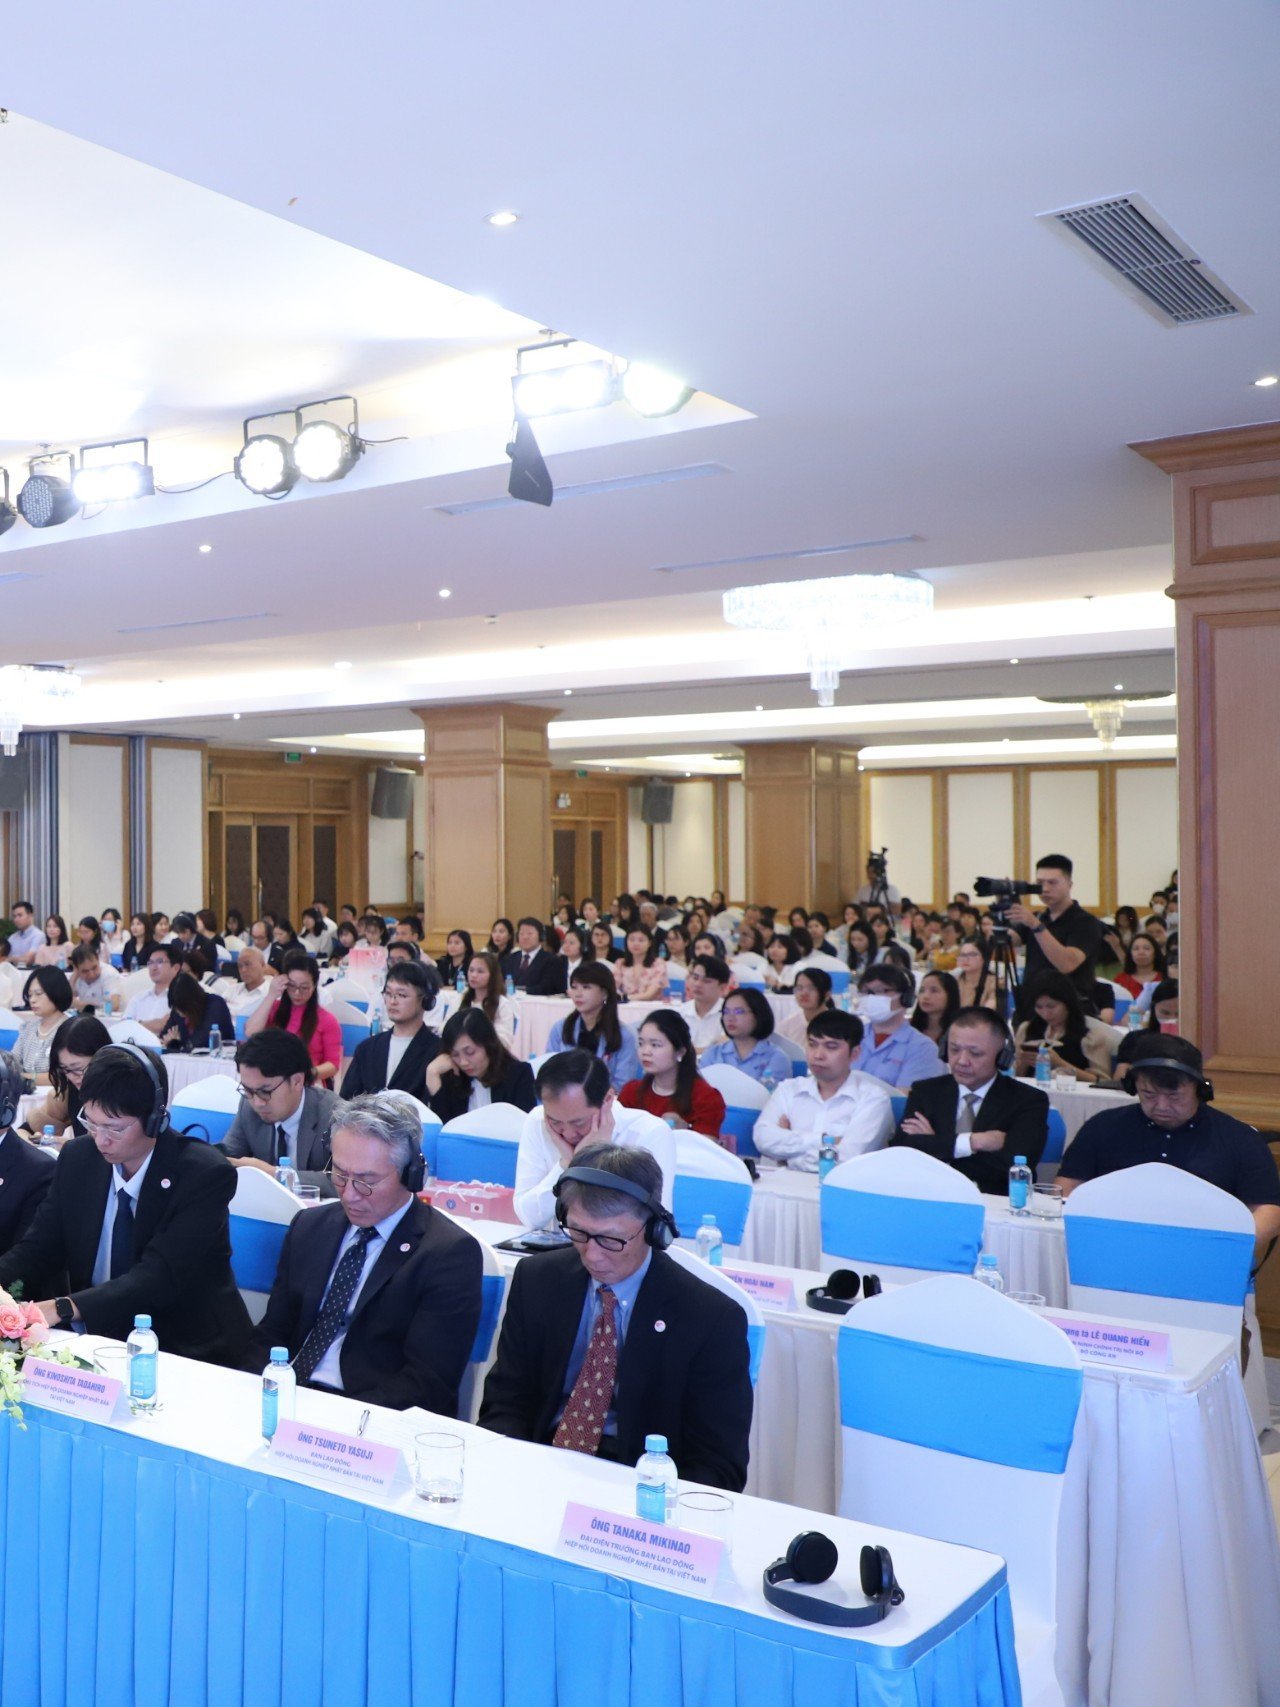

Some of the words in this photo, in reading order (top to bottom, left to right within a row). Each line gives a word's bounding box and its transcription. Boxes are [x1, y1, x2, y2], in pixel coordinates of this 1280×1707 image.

[760, 1280, 774, 1288] NAM
[1102, 1332, 1129, 1344] QUANG
[1089, 1349, 1107, 1357] CÔNG
[46, 1370, 77, 1386] KINOSHITA
[297, 1431, 313, 1444] ÔNG
[314, 1436, 346, 1453] TSUNETO
[348, 1445, 373, 1460] YASUJI
[310, 1452, 322, 1460] BAN
[322, 1455, 334, 1463] LAO
[293, 1455, 311, 1465] DOANH
[372, 1477, 384, 1485] NAM
[591, 1516, 610, 1533] ÔNG
[612, 1524, 647, 1543] TANAKA
[649, 1534, 691, 1555] MIKINAO
[641, 1550, 656, 1561] BAN
[656, 1555, 671, 1565] LAO
[590, 1546, 612, 1557] DOANH
[691, 1574, 707, 1585] NAM
